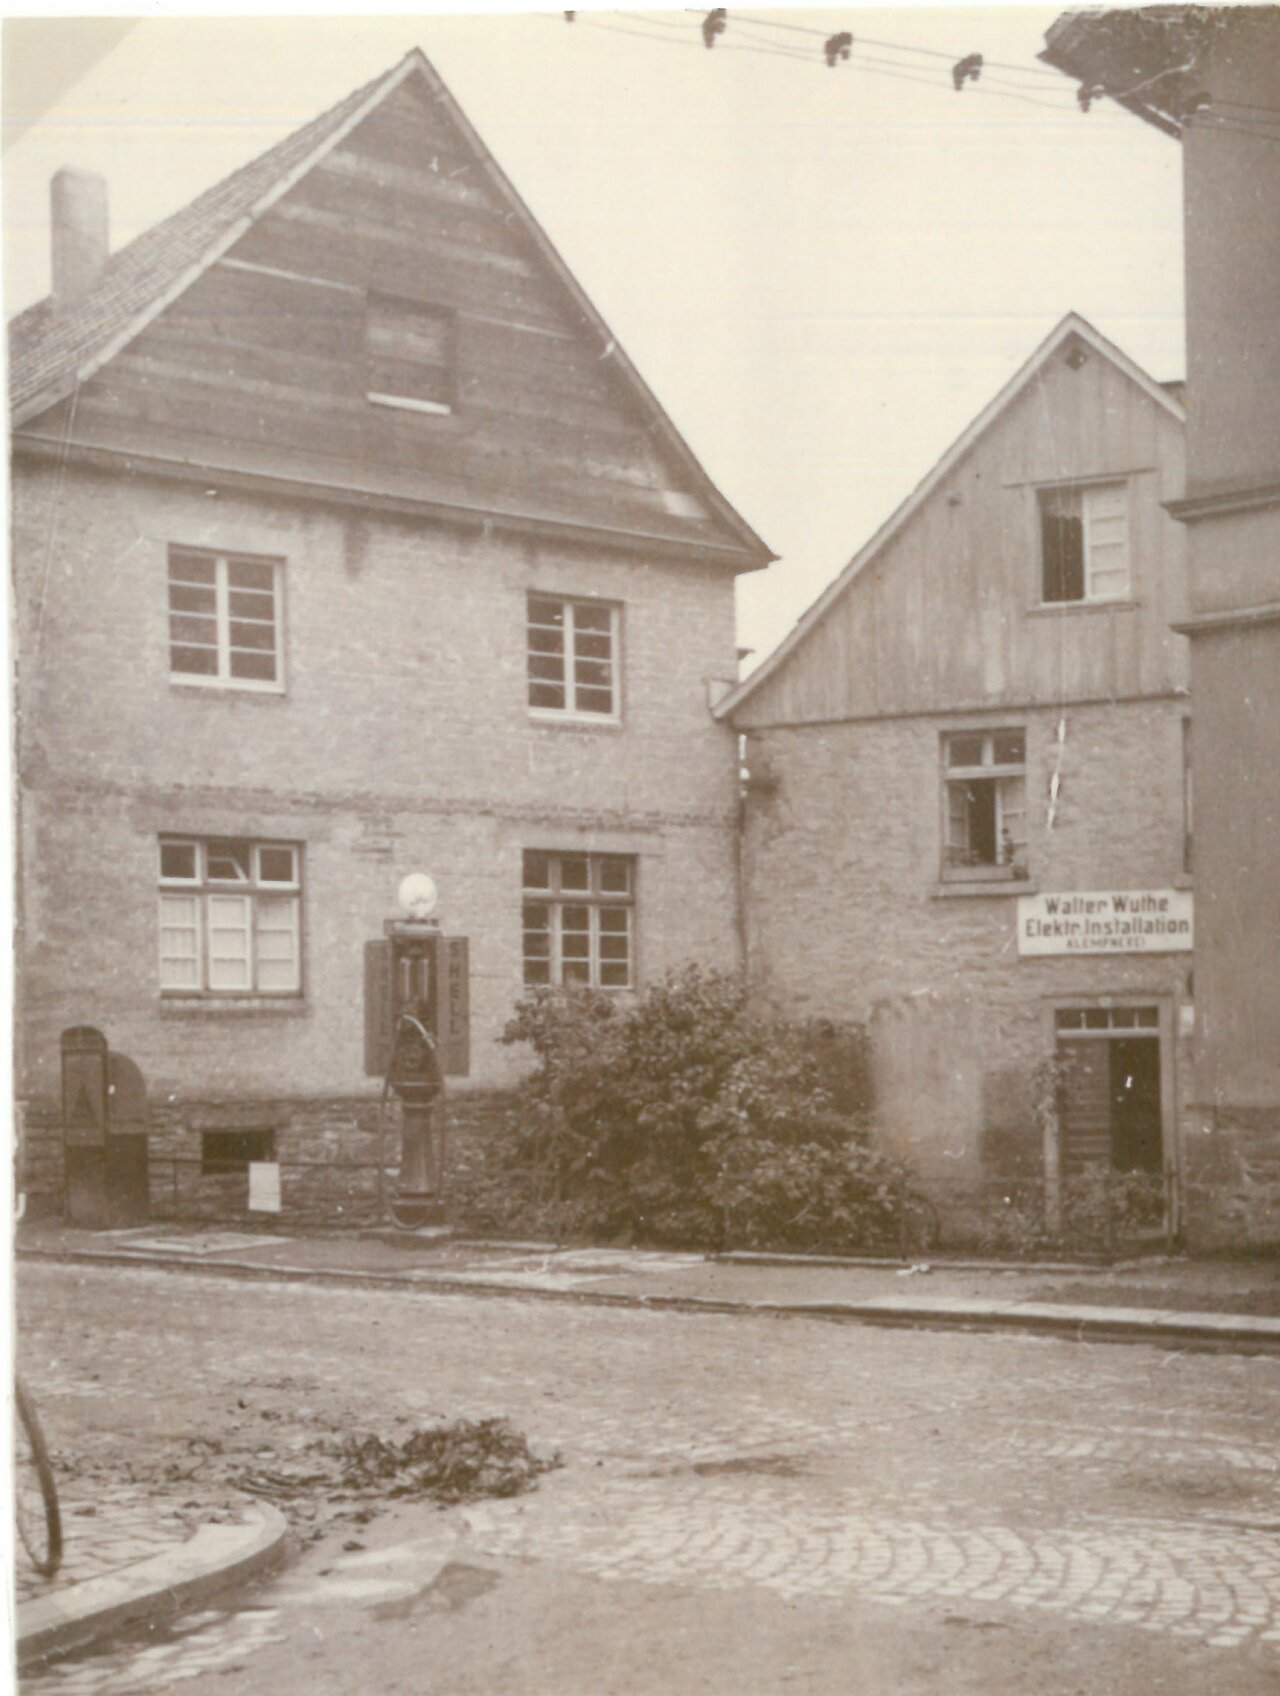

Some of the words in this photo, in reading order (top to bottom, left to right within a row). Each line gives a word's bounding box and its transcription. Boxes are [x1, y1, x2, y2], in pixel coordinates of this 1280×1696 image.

[1045, 896, 1108, 914] Walter
[1111, 894, 1169, 914] Wuthe
[1085, 915, 1190, 936] Installation
[448, 941, 461, 1036] SHELL
